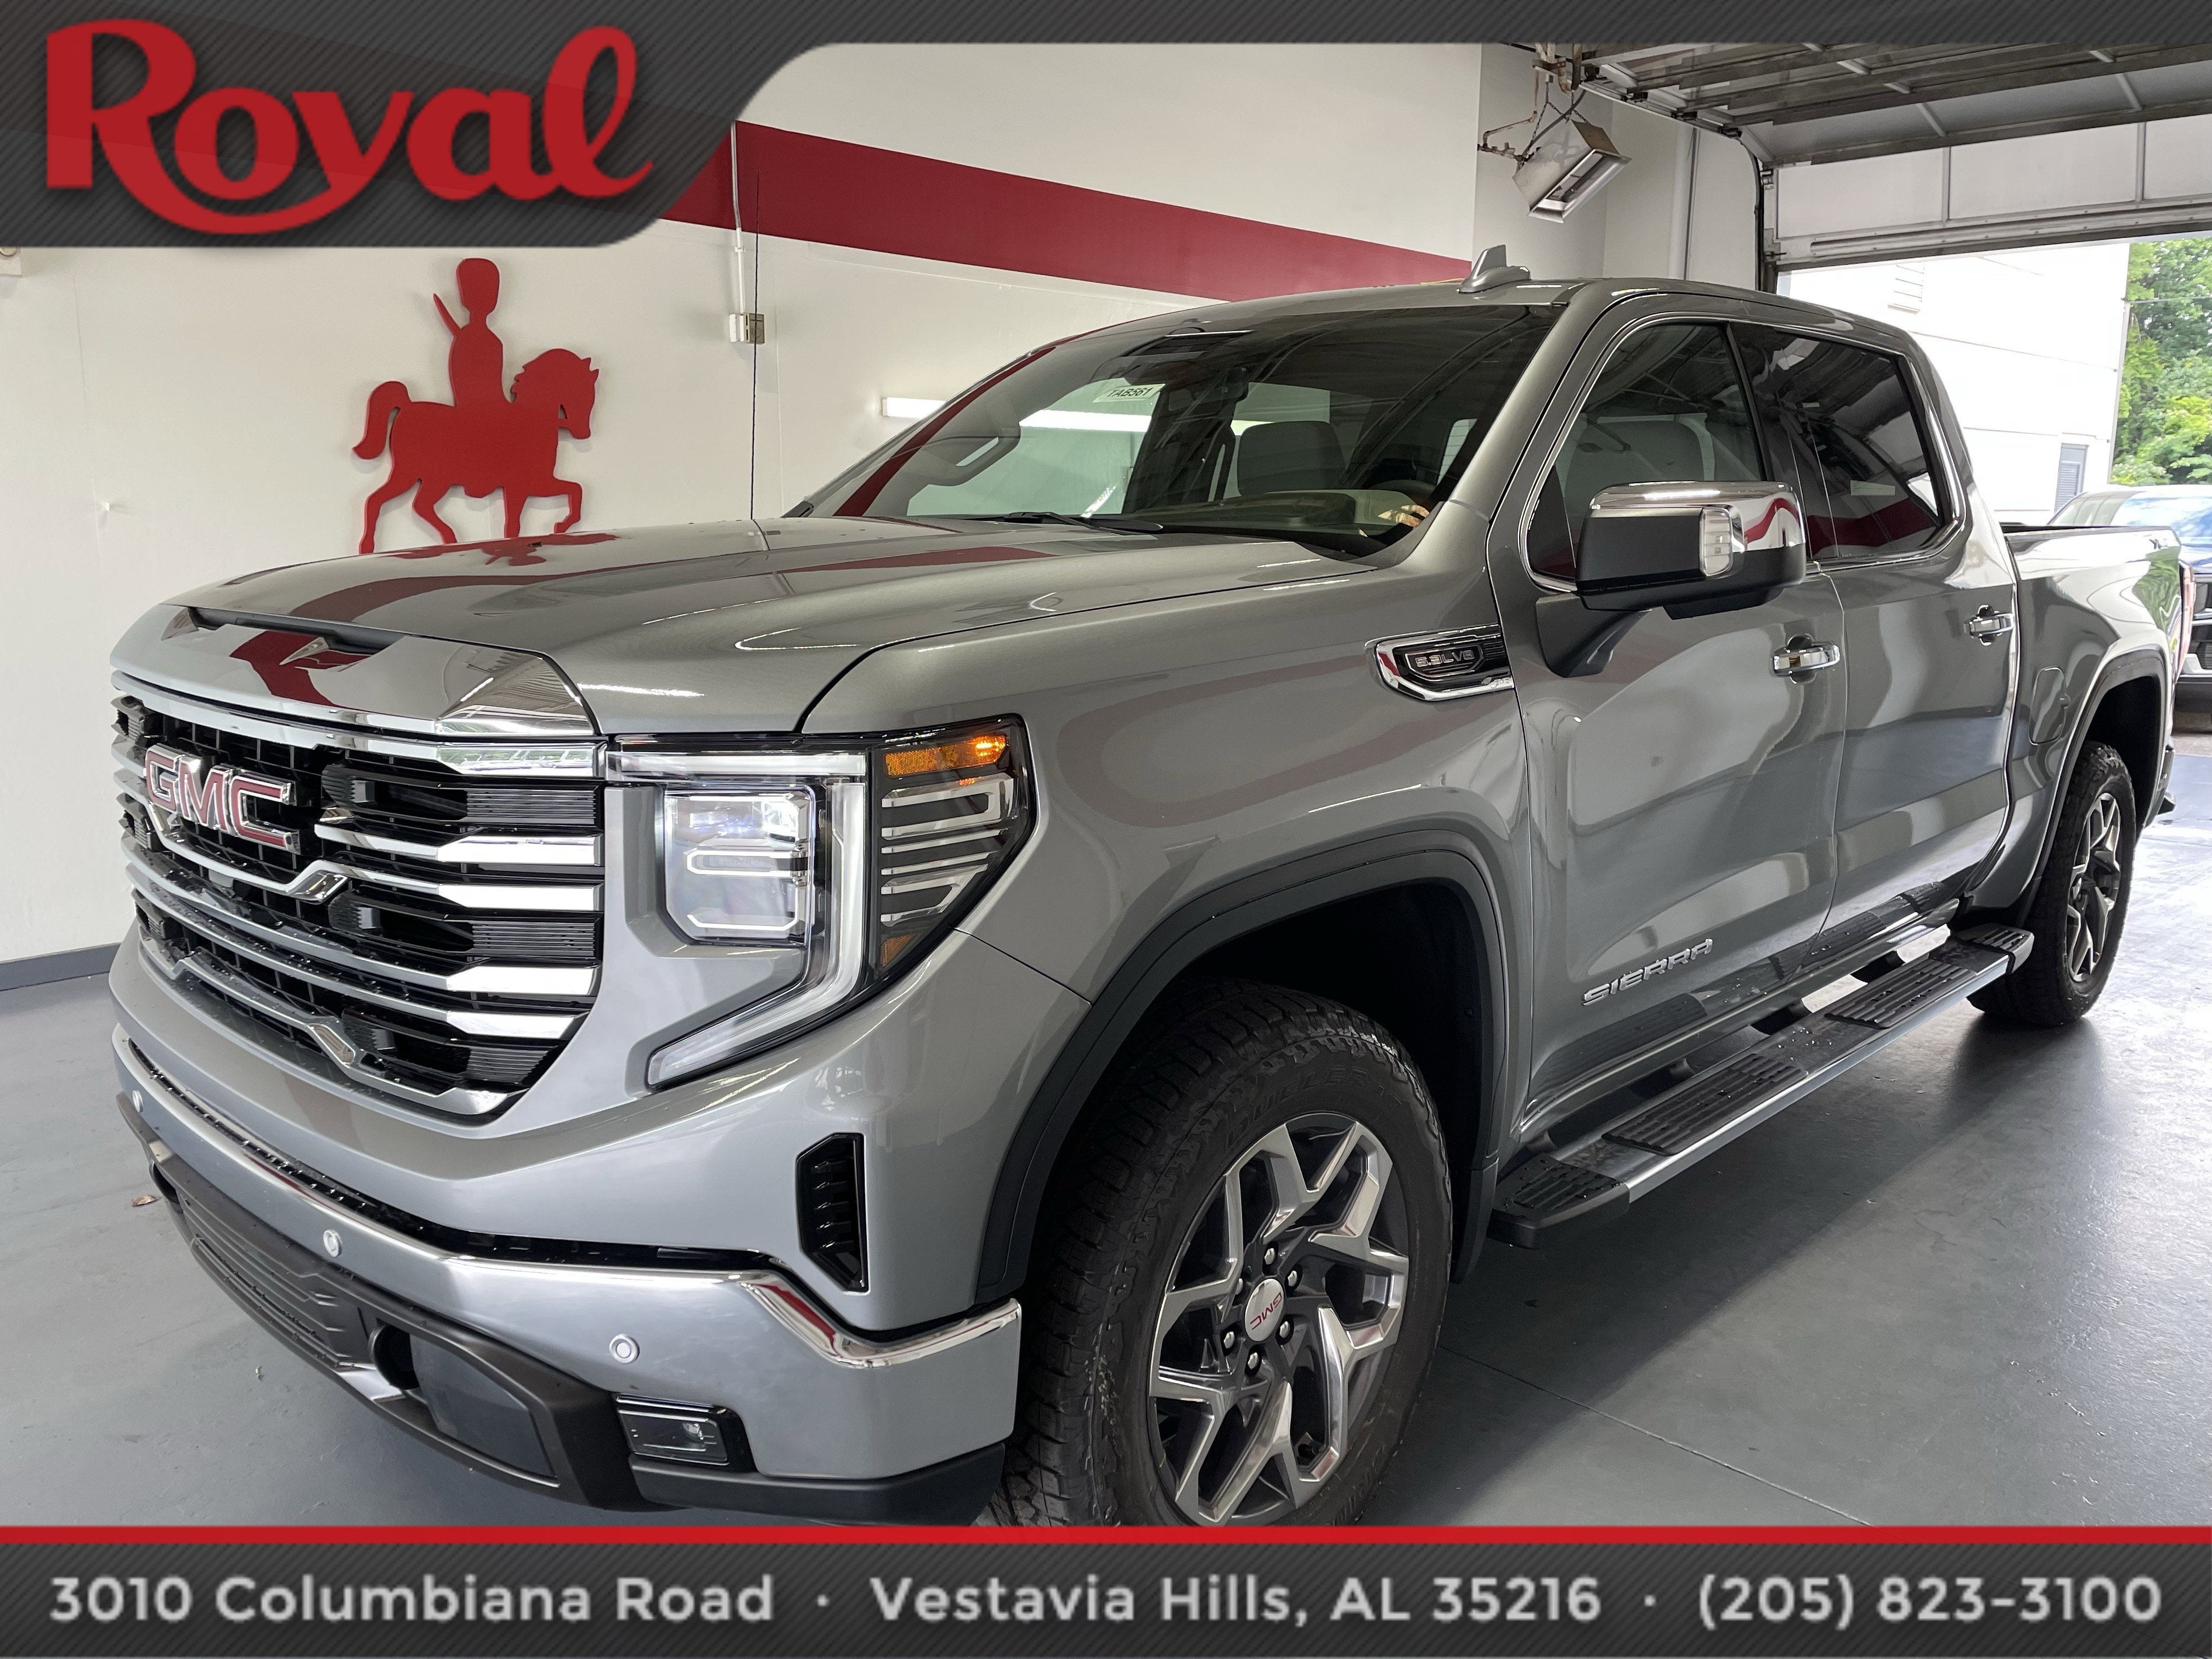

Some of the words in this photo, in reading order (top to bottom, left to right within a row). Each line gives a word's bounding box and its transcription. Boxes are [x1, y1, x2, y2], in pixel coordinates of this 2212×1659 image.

[145, 744, 300, 855] GMC
[1582, 938, 1713, 1006] SIERRA
[1250, 1292, 1283, 1330] GMC
